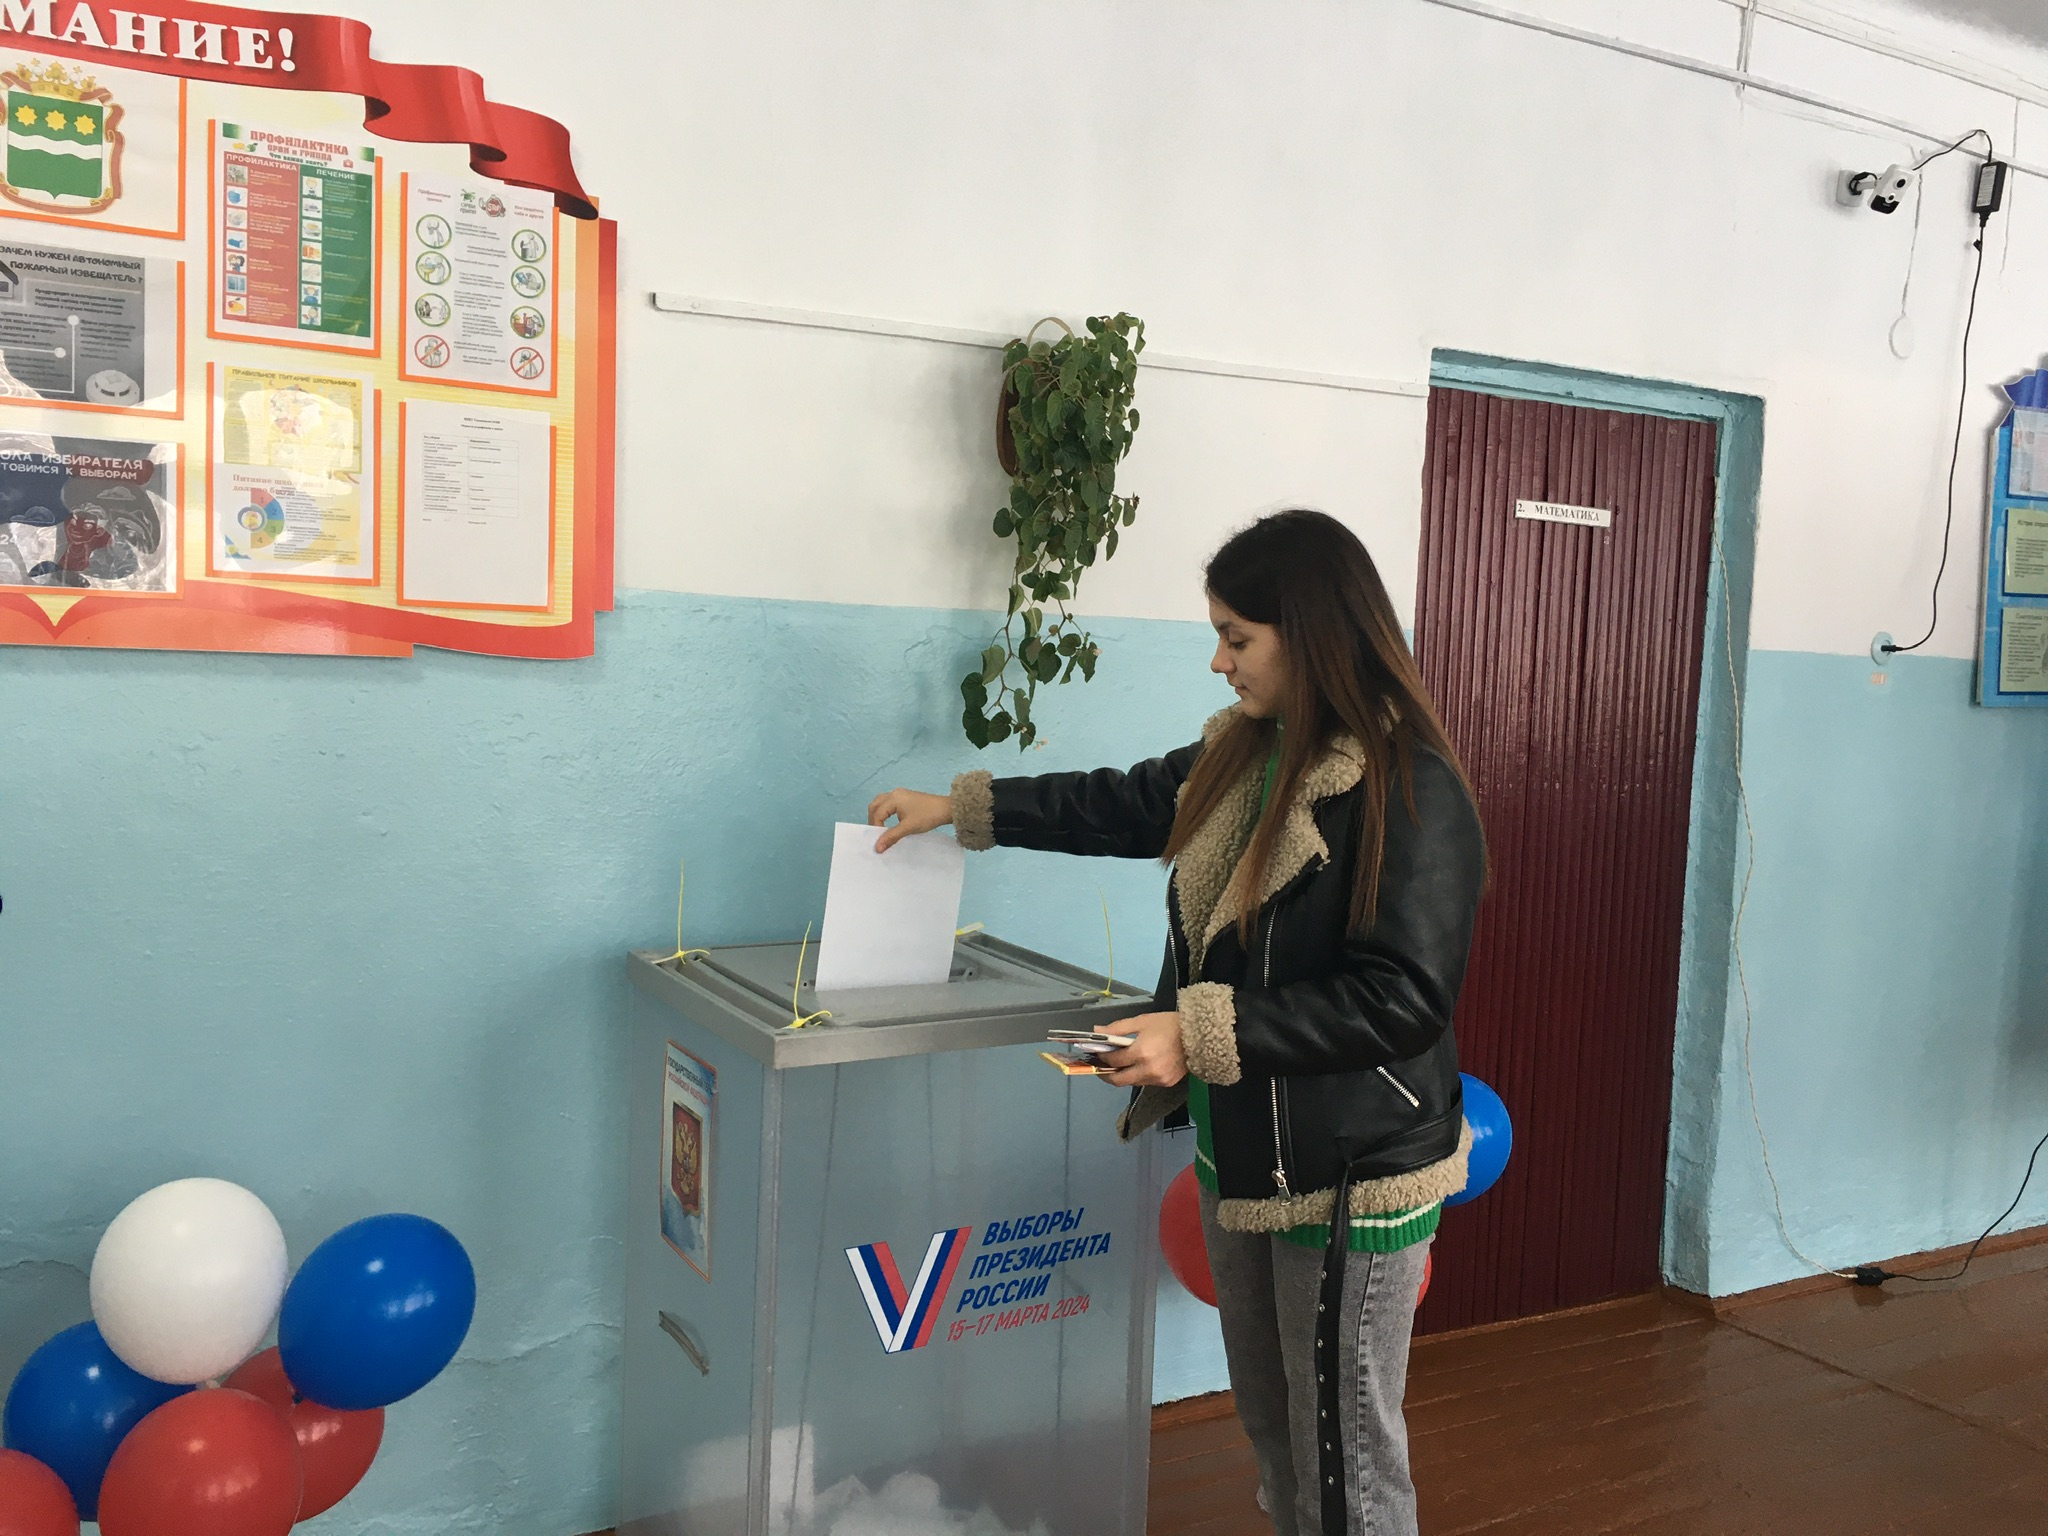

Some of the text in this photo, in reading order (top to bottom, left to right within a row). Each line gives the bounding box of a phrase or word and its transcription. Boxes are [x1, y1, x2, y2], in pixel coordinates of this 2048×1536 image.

[250, 130, 349, 155] ПРОФИЛАКТИКА
[267, 144, 290, 154] ОРВИ
[300, 149, 333, 161] ГРИППА
[226, 153, 297, 171] ПРОФИЛАКТИКА
[316, 169, 355, 180] ЛЕЧЕНИЕ
[0, 245, 141, 270] ЗАЧЕМ НУЖЕН АВТОНОМНЫЙ
[10, 260, 68, 275] ПОЖАРНЫЙ
[70, 269, 136, 284] ИЗВЕЩАТЕЛЬ
[231, 368, 357, 388] ПРАВИЛЬНОЕ ПИТАНИЕ ШКОЛЬНИКОВ
[0, 462, 137, 480] ТОВИМСЯ К ВЫБОРАМ
[42, 453, 143, 470] ИЗБИРАТЕЛЯ
[232, 474, 272, 484] Питание
[1517, 503, 1600, 521] 2. МАТЕМАТИКА
[981, 1207, 1085, 1247] ВЫБОРЫ
[968, 1232, 1112, 1280] ПРЕЗИДЕНТА
[956, 1273, 1051, 1314] РОССИИ
[994, 1303, 1049, 1332] МАРТА
[1051, 1294, 1091, 1320] 2024
